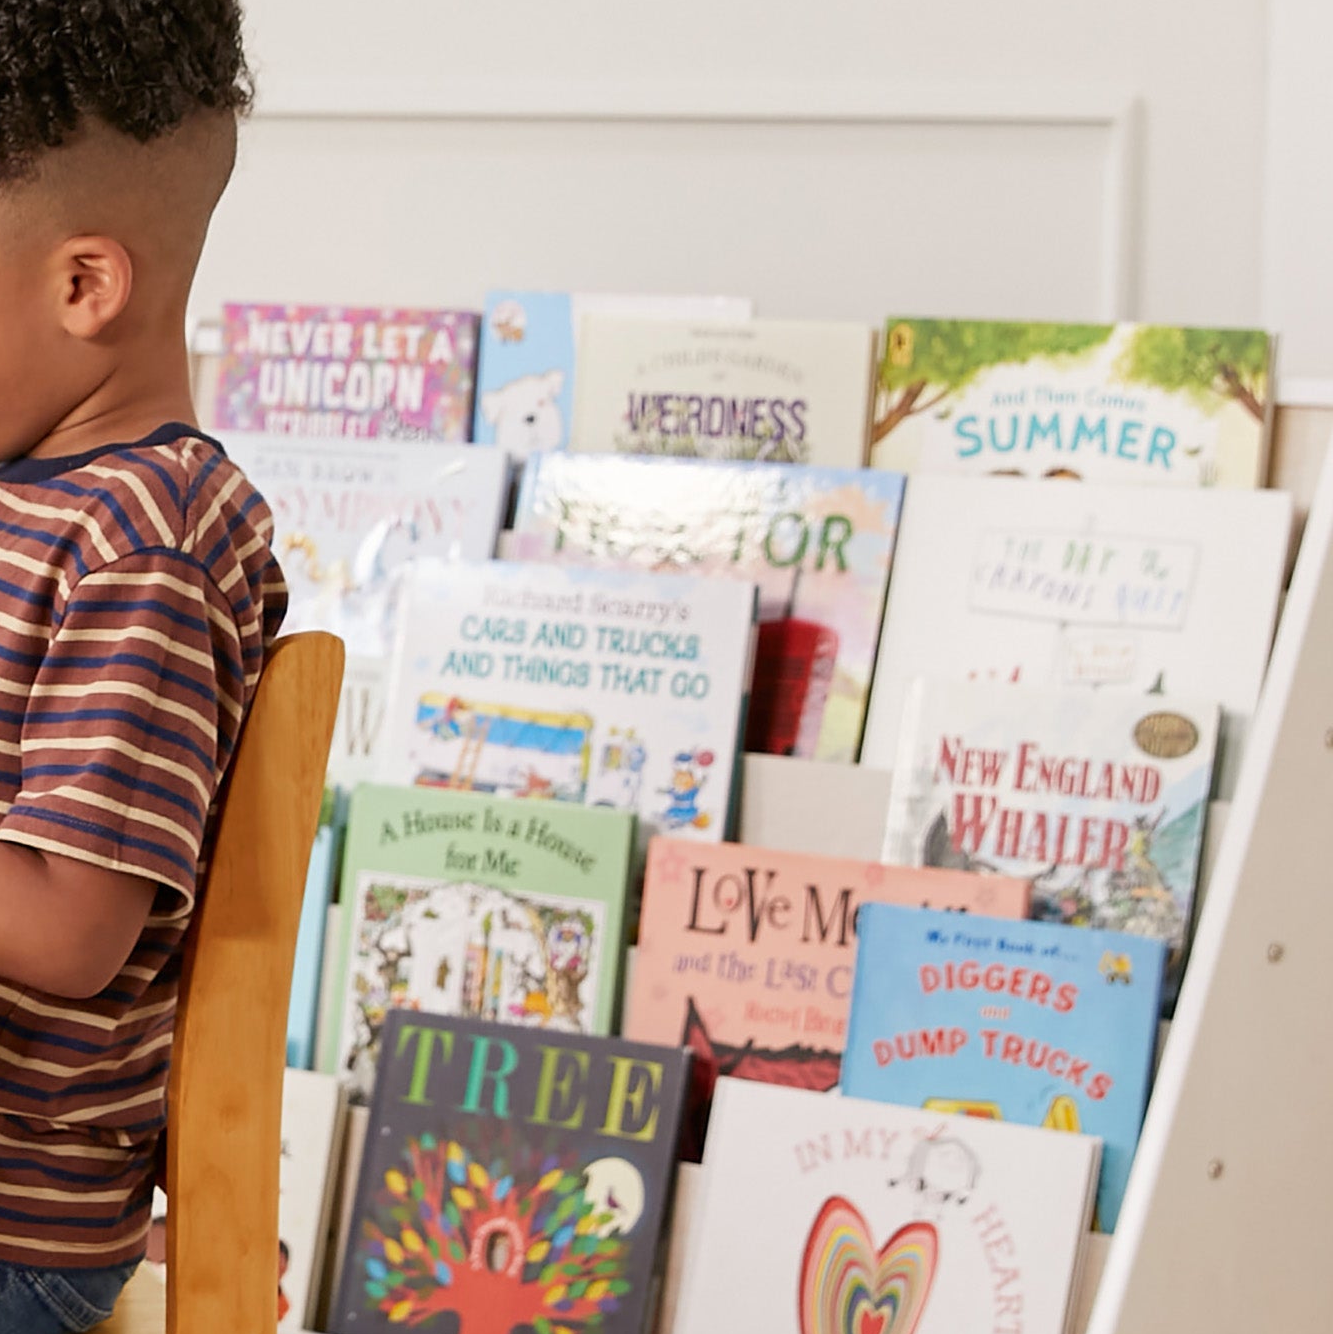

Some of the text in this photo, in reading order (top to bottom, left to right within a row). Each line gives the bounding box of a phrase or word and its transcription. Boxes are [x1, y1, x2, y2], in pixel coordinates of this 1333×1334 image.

[248, 318, 455, 365] NEVER LET A
[258, 359, 426, 413] UNICORN
[954, 410, 1177, 469] SUMMER
[459, 614, 701, 661] CARS AND TRUCKS
[440, 650, 711, 699] AND THINGS THAT GO
[1013, 741, 1161, 805] ENGLAND
[380, 819, 400, 845] A
[402, 807, 477, 838] House
[523, 815, 599, 874] House
[445, 839, 522, 878] for Me
[950, 792, 1130, 872] WHALER
[918, 960, 1080, 1014] DIGGERS
[393, 1024, 665, 1144] TREE
[872, 1027, 1116, 1102] DUMP TRUCKS
[794, 1127, 901, 1175] IN MY
